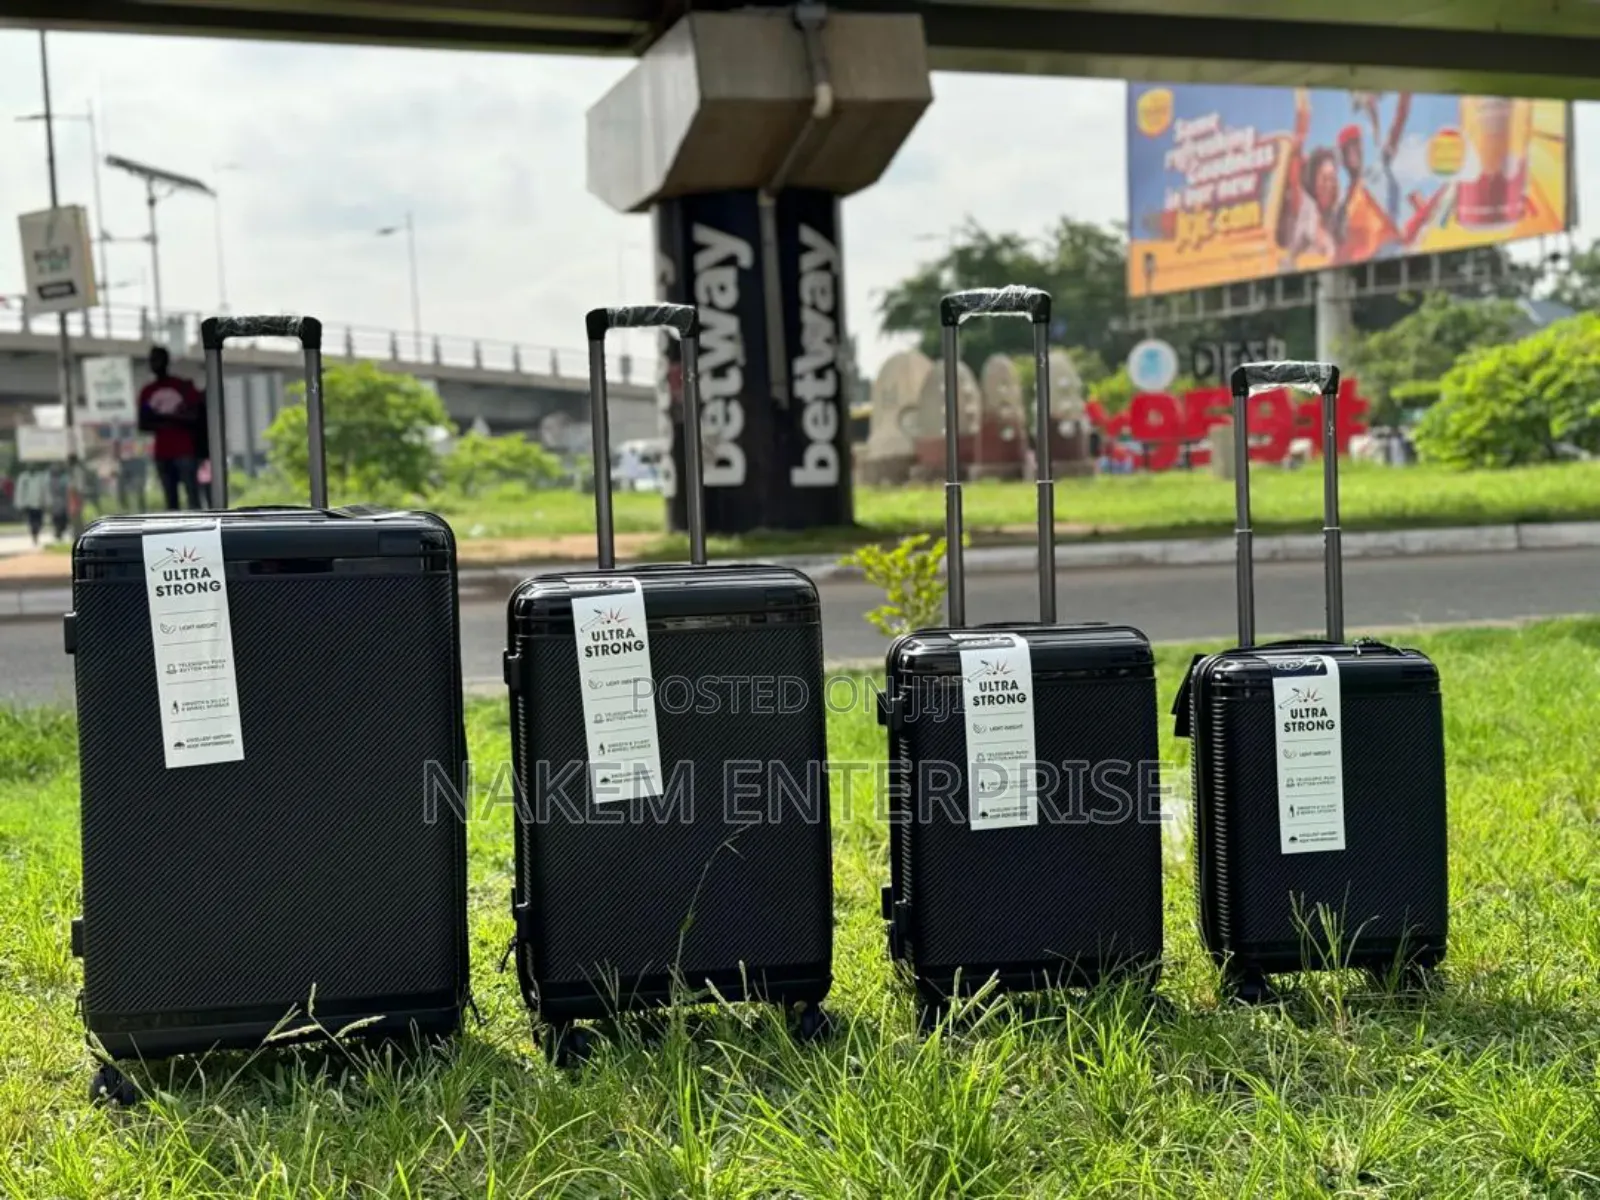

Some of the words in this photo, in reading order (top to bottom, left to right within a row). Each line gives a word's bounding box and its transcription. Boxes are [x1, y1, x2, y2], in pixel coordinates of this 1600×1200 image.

[693, 221, 753, 486] betway
[790, 221, 840, 486] betway
[163, 566, 211, 582] ULTRA
[155, 580, 222, 598] STRONG
[591, 627, 636, 642] ULTRA
[585, 640, 645, 658] STRONG
[979, 679, 1019, 693] ULTRA
[972, 692, 1027, 707] STRONG
[1290, 707, 1328, 719] ULTRA
[1284, 719, 1335, 733] STRONG
